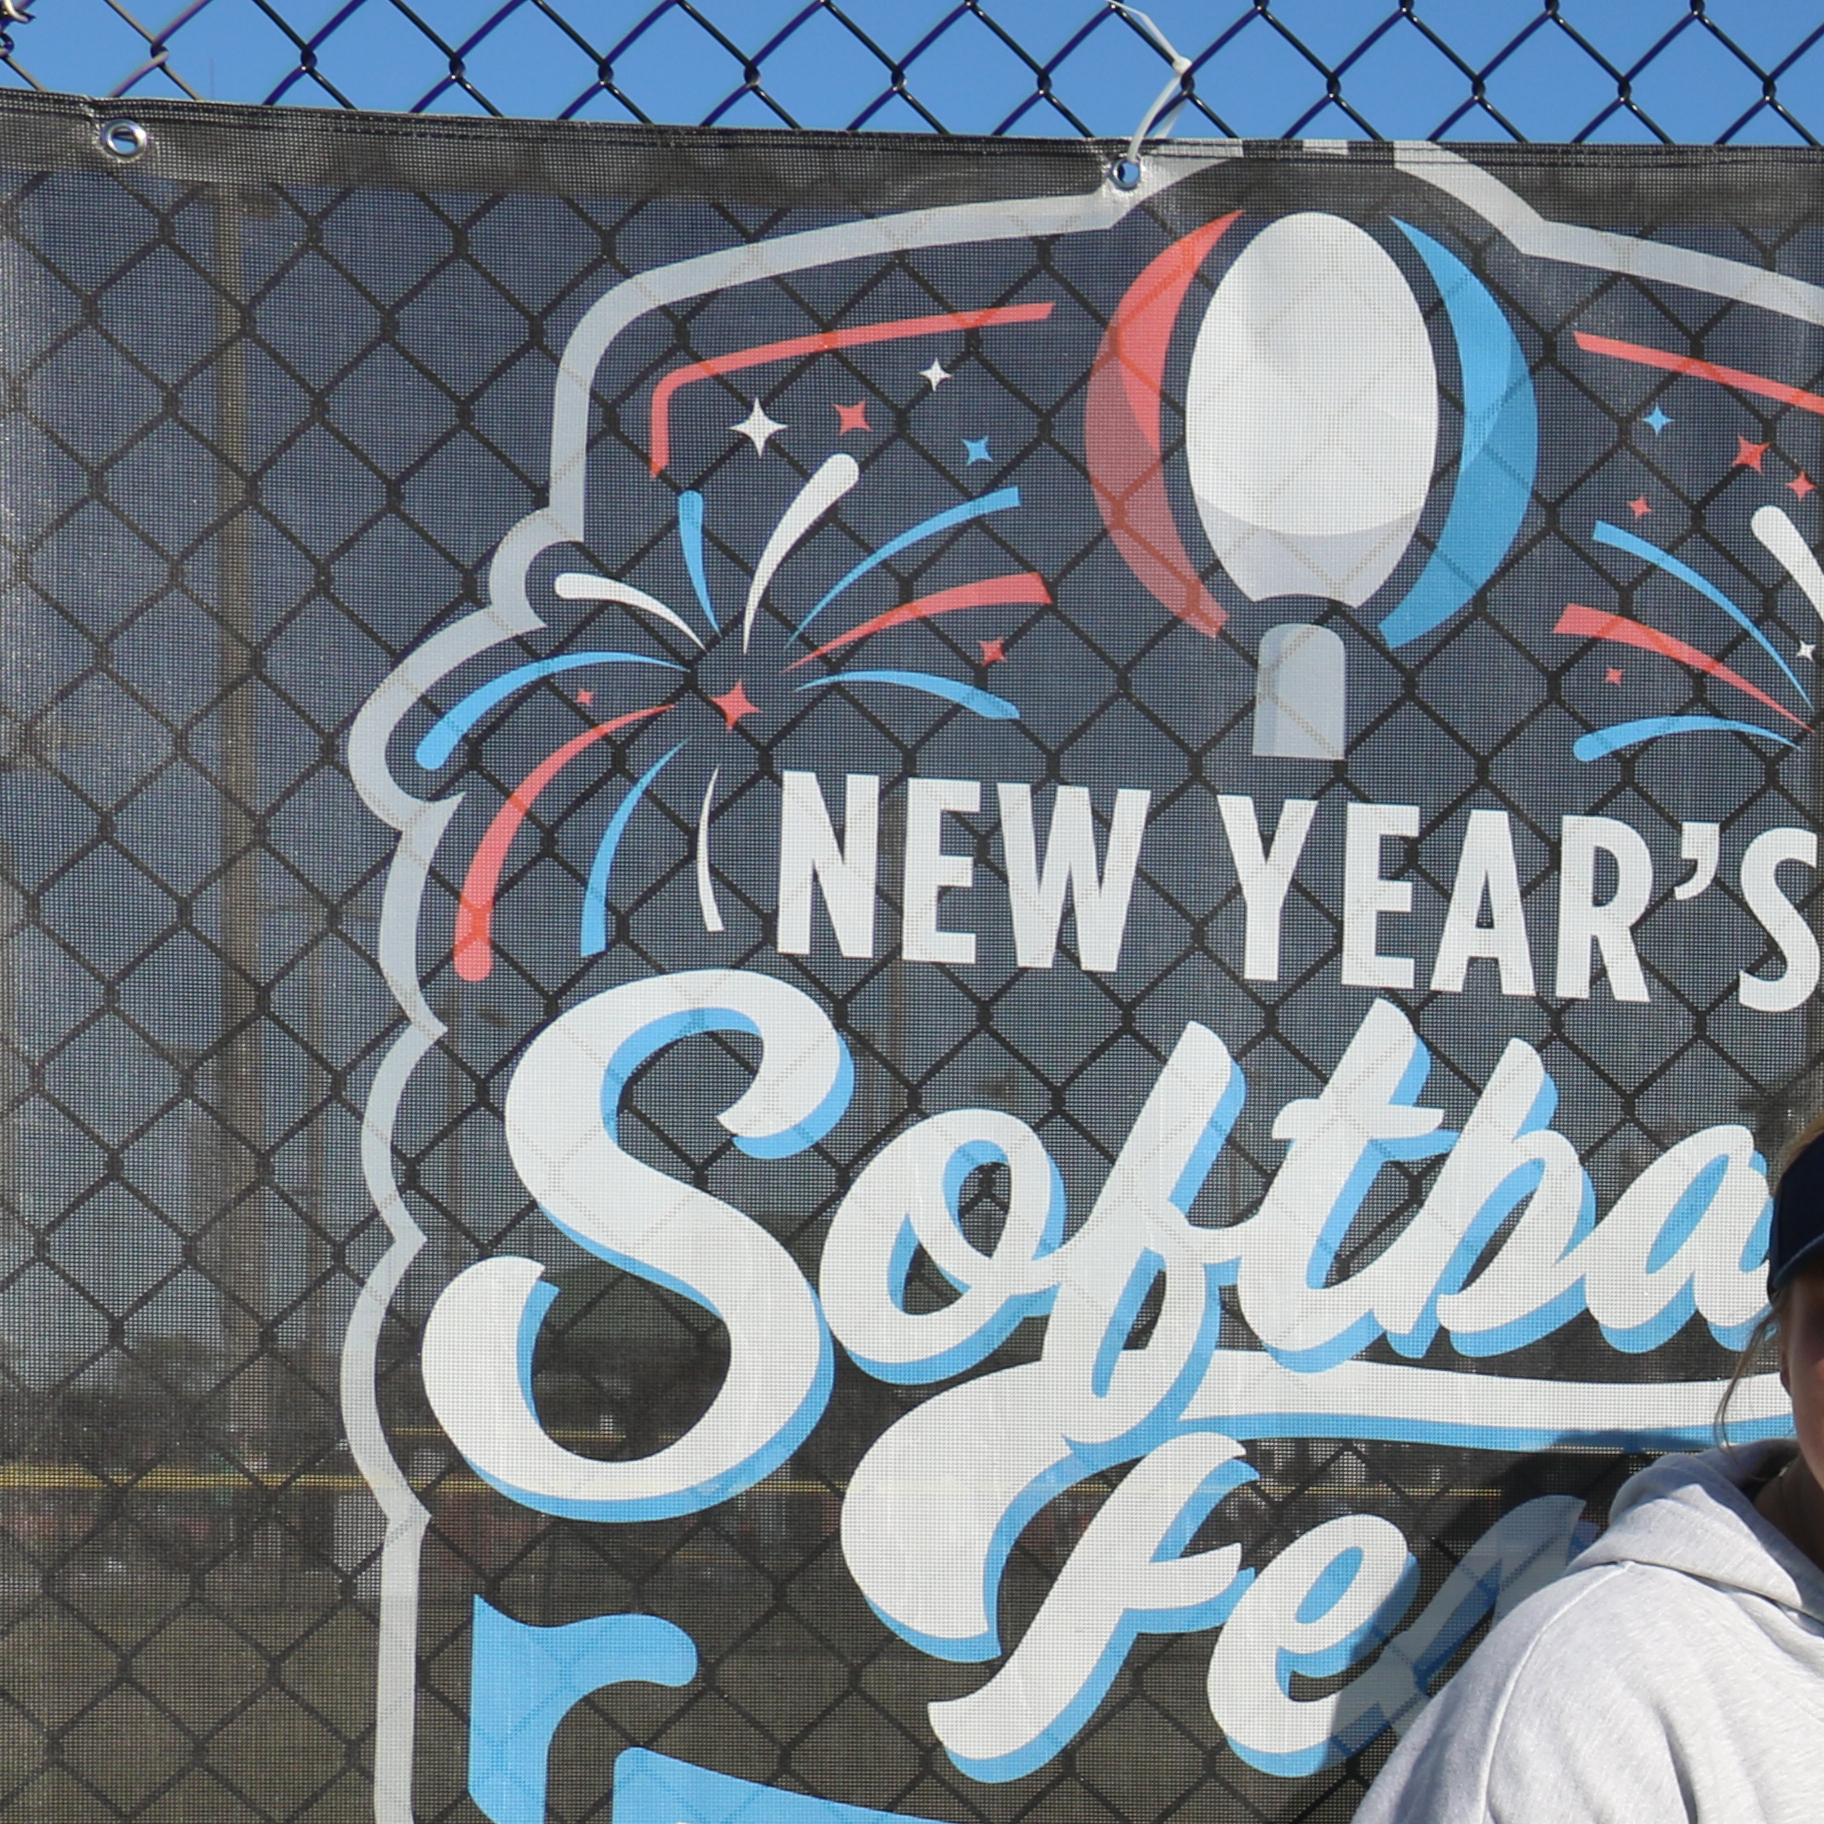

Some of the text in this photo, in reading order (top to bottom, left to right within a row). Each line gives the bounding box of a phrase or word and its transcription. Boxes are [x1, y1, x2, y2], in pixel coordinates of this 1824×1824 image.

[775, 771, 1820, 1012] NEW YEAR'S
[840, 1350, 1600, 1781] Fe
